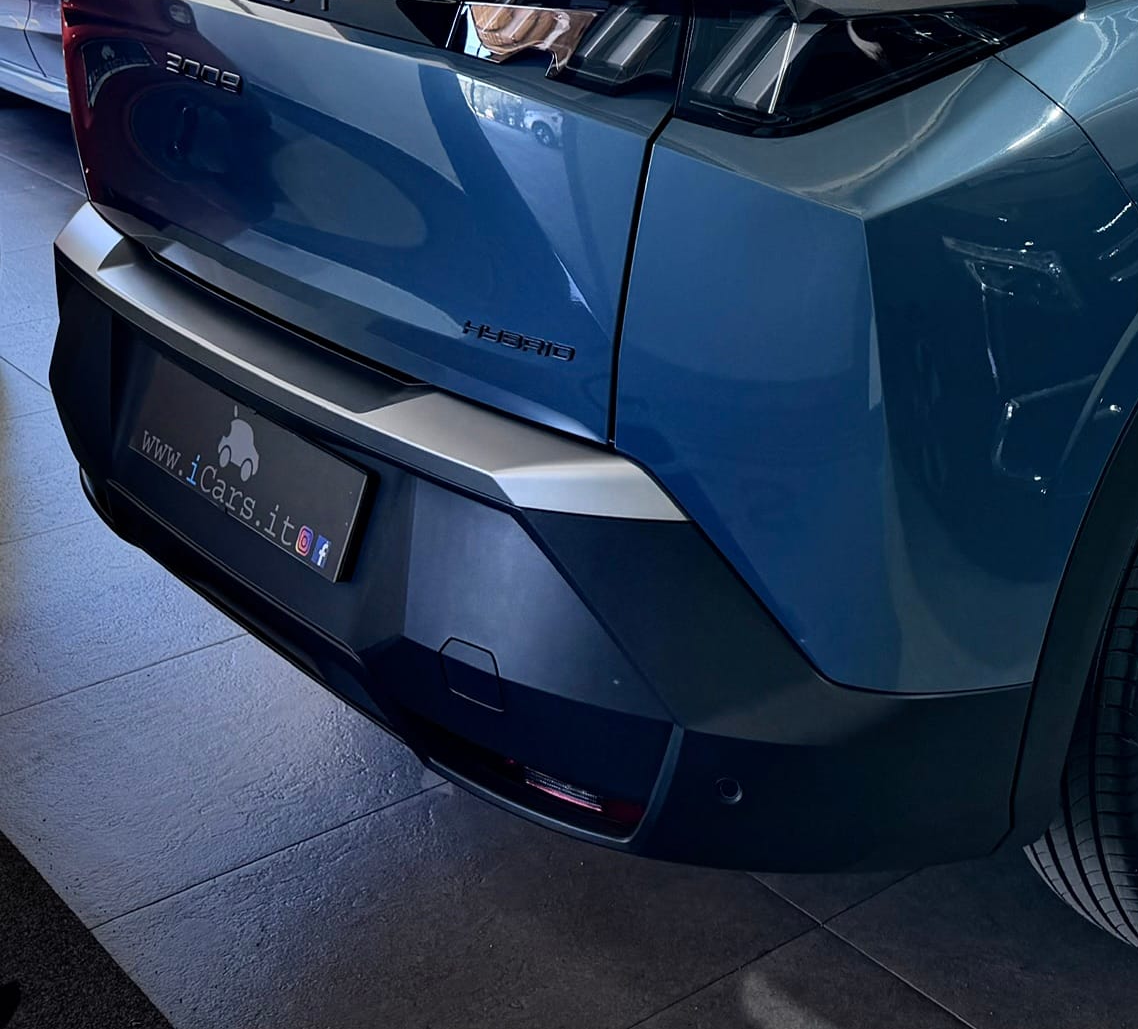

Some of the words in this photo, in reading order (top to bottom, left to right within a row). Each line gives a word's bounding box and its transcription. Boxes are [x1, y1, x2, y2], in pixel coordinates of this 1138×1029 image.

[165, 51, 242, 93] 3008
[462, 320, 576, 362] HYBRID
[140, 430, 295, 546] www.iCars.it
